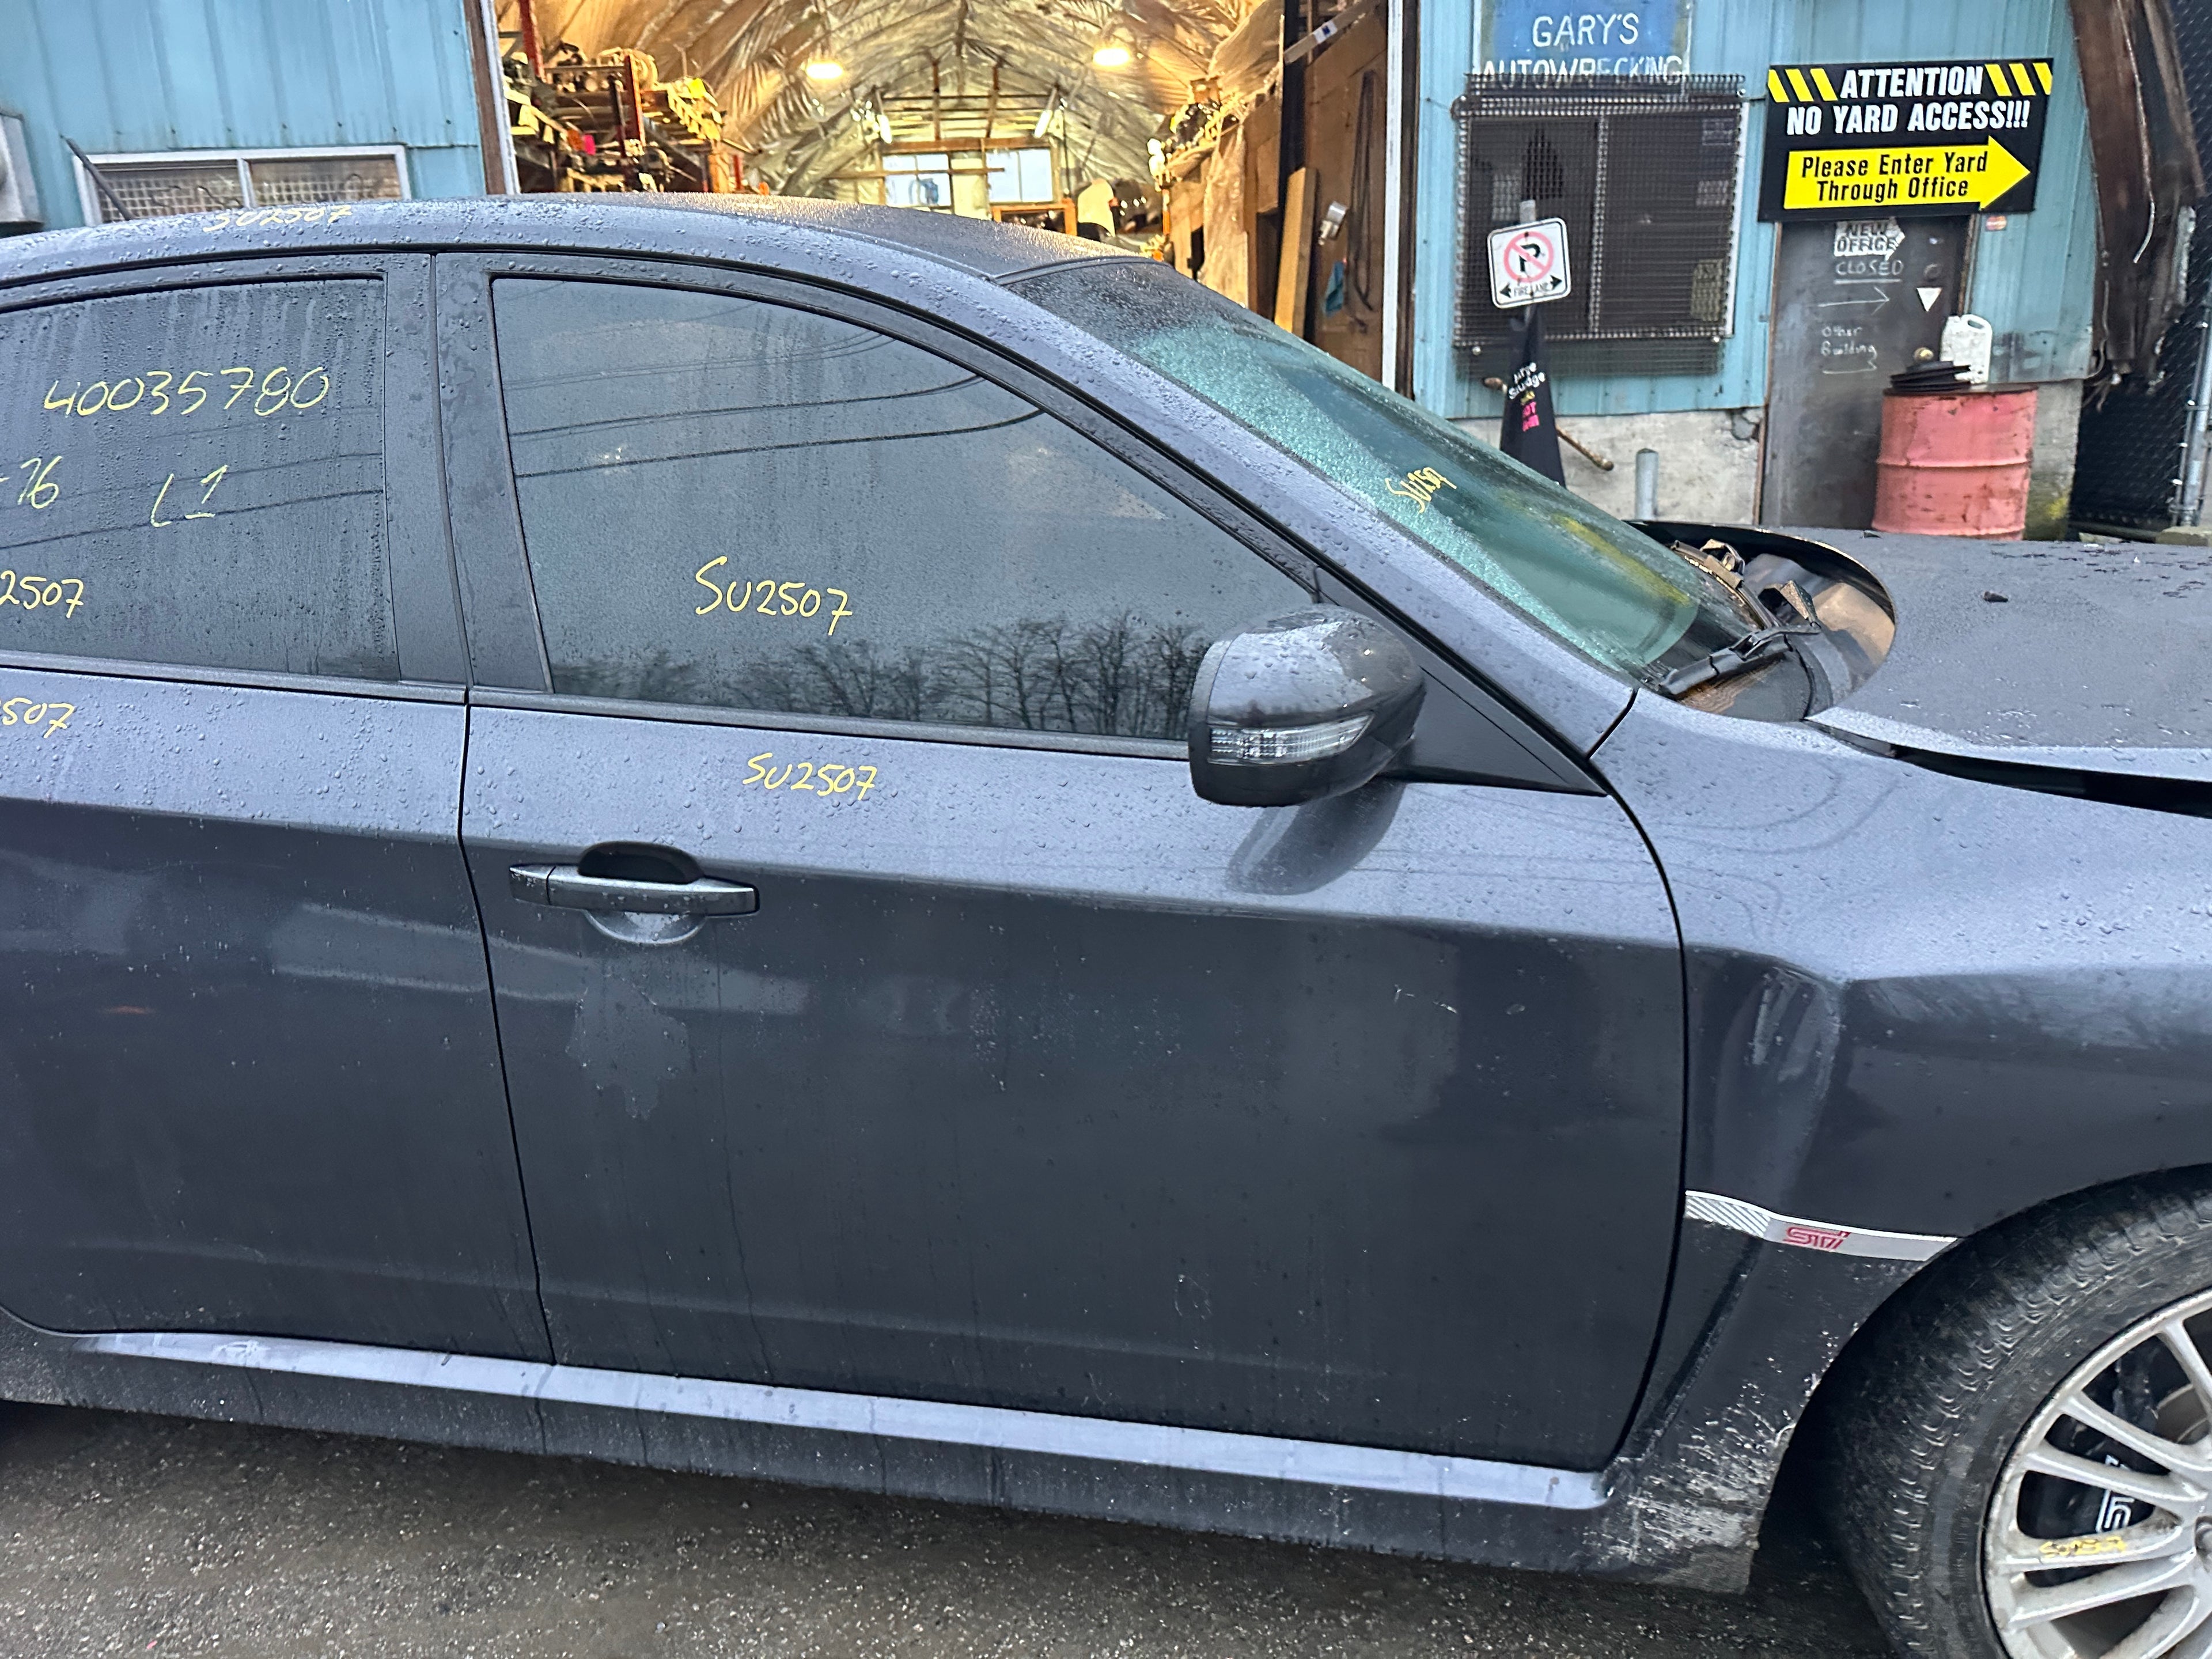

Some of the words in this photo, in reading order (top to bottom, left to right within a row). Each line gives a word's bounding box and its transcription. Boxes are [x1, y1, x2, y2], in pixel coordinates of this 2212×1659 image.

[1532, 13, 1639, 48] GARY'S
[1840, 66, 1983, 99] ATTENTION
[1786, 106, 1822, 135] NO
[1833, 104, 1899, 134] YARD
[1907, 100, 2031, 132] ACCESS!!!
[1802, 156, 1869, 178] Please
[1879, 153, 1934, 175] Enter
[1945, 151, 1988, 172] Yard
[1817, 179, 1898, 203] Through
[1908, 176, 1968, 197] Office
[1835, 259, 1904, 276] CLOSED
[44, 366, 329, 417] 40035780
[0, 570, 84, 618] 2507
[695, 555, 853, 636] SU2507
[0, 696, 75, 739] 507
[743, 752, 878, 801] SU2507
